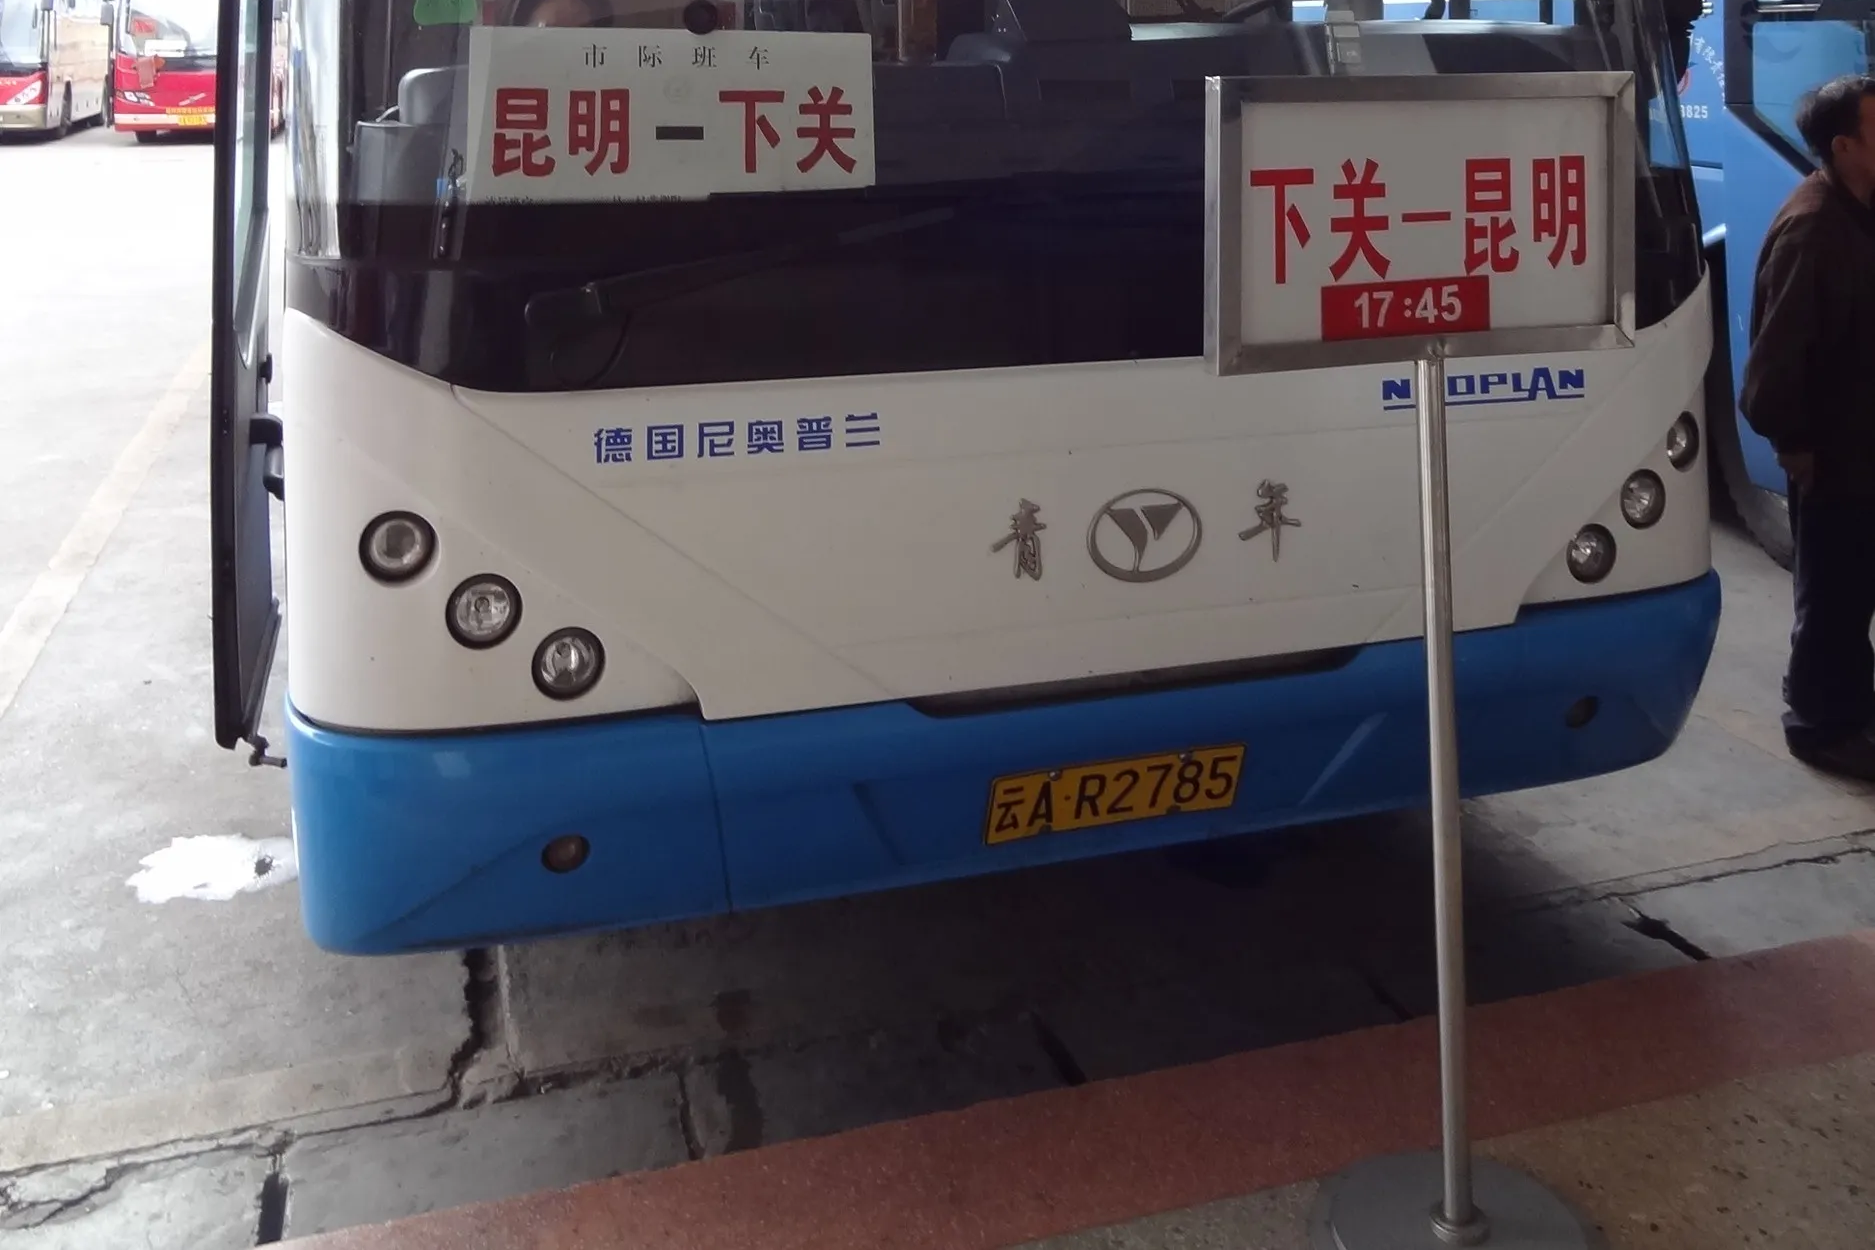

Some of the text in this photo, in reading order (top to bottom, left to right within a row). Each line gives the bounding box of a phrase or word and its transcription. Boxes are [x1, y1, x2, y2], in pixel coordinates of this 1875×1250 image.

[582, 44, 770, 70] 市际班车
[1354, 284, 1463, 329] 17:45
[1382, 367, 1585, 401] NOPLAN
[593, 412, 882, 464] 德国尼奥普兰
[990, 479, 1302, 581] 青 年
